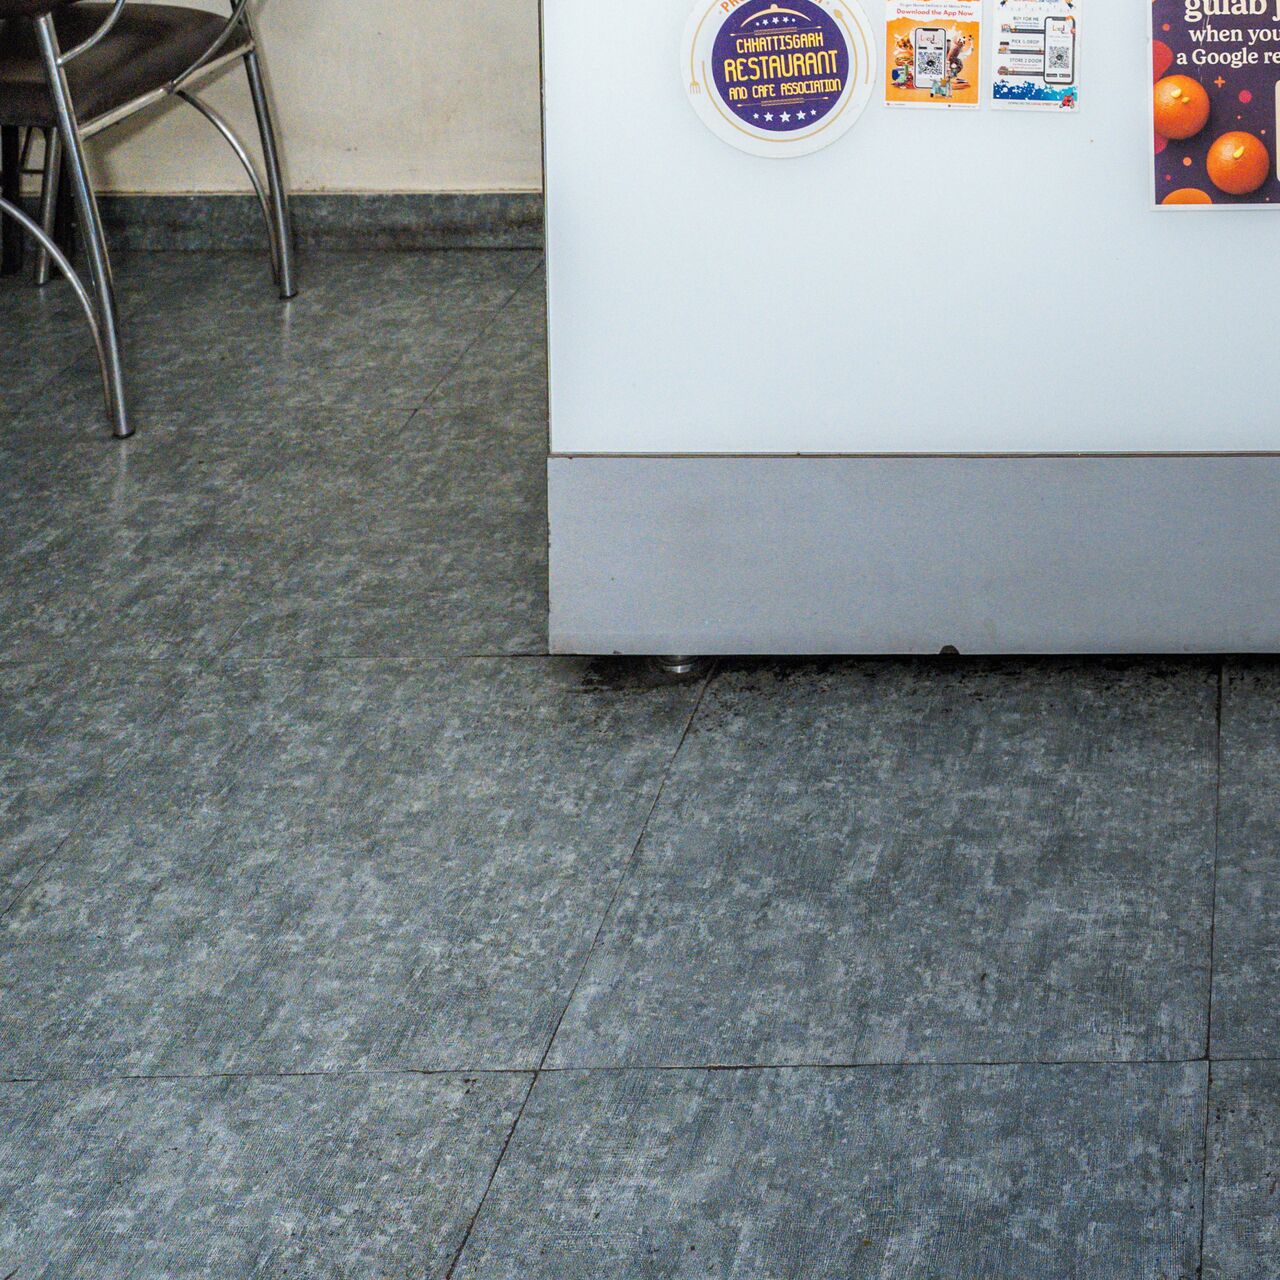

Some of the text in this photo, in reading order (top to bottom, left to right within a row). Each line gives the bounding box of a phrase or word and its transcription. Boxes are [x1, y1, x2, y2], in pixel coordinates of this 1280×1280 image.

[736, 32, 824, 54] CHHATTISGARH
[1188, 25, 1243, 42] when
[724, 50, 838, 83] RESTAURANT
[1176, 53, 1188, 65] a
[1192, 47, 1259, 68] Google
[729, 78, 842, 100] AND CAFE ASSOCIATION
